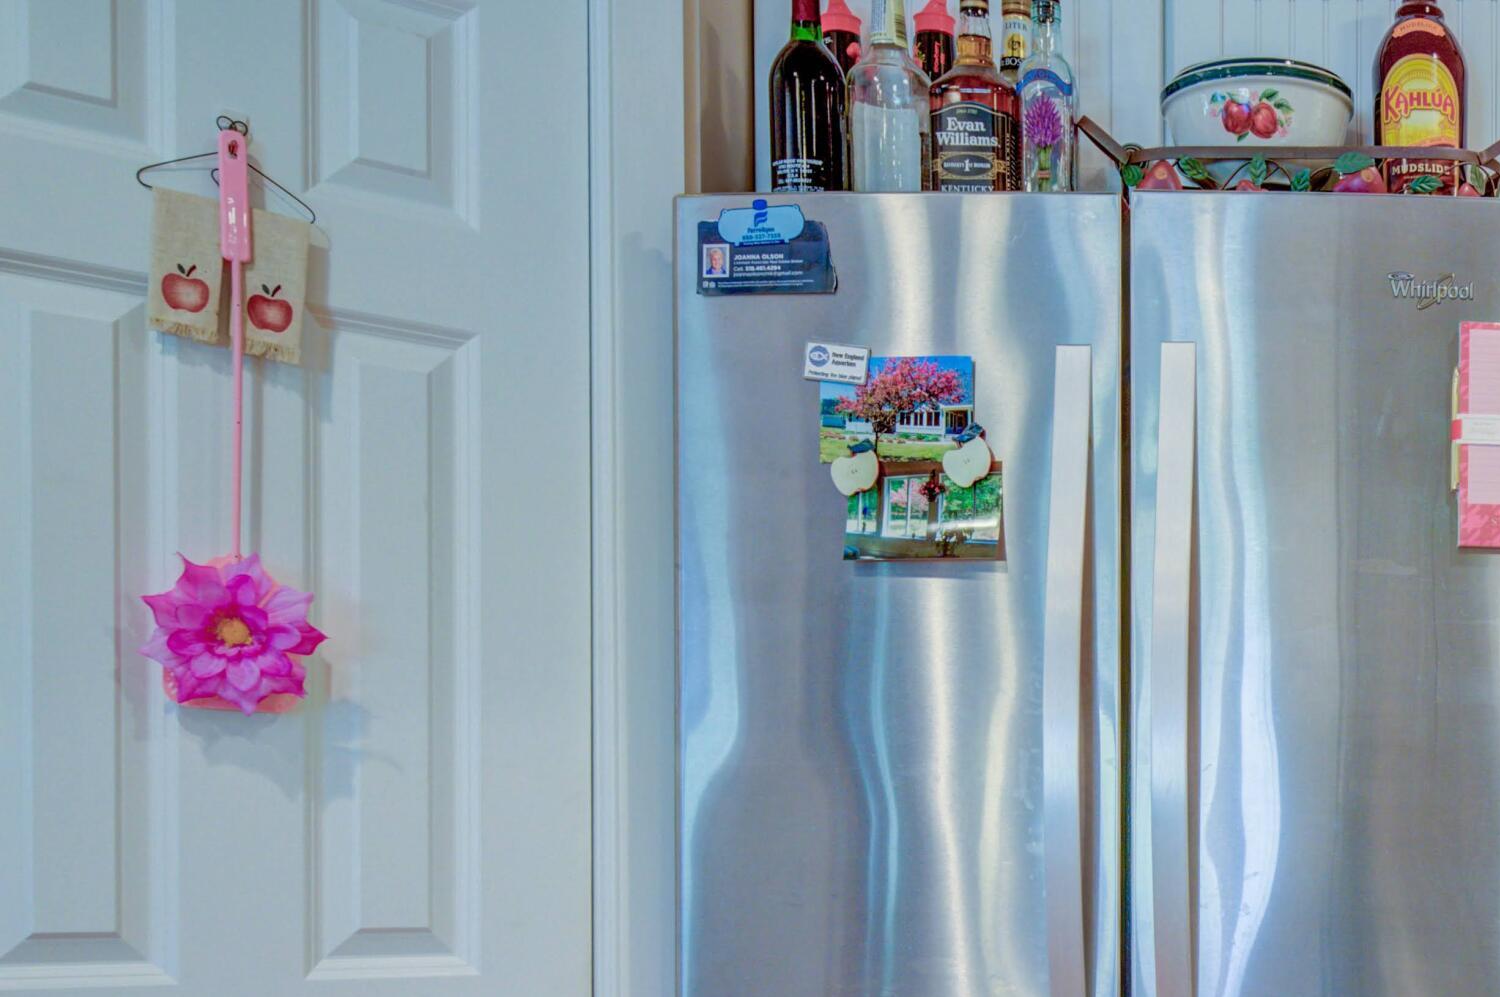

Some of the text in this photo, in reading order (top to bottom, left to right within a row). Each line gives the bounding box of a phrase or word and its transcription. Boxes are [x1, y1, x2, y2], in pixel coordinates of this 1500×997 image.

[1384, 84, 1457, 124] KAHLÚA
[946, 117, 986, 132] Evan
[1389, 277, 1474, 305] Whirlpool
